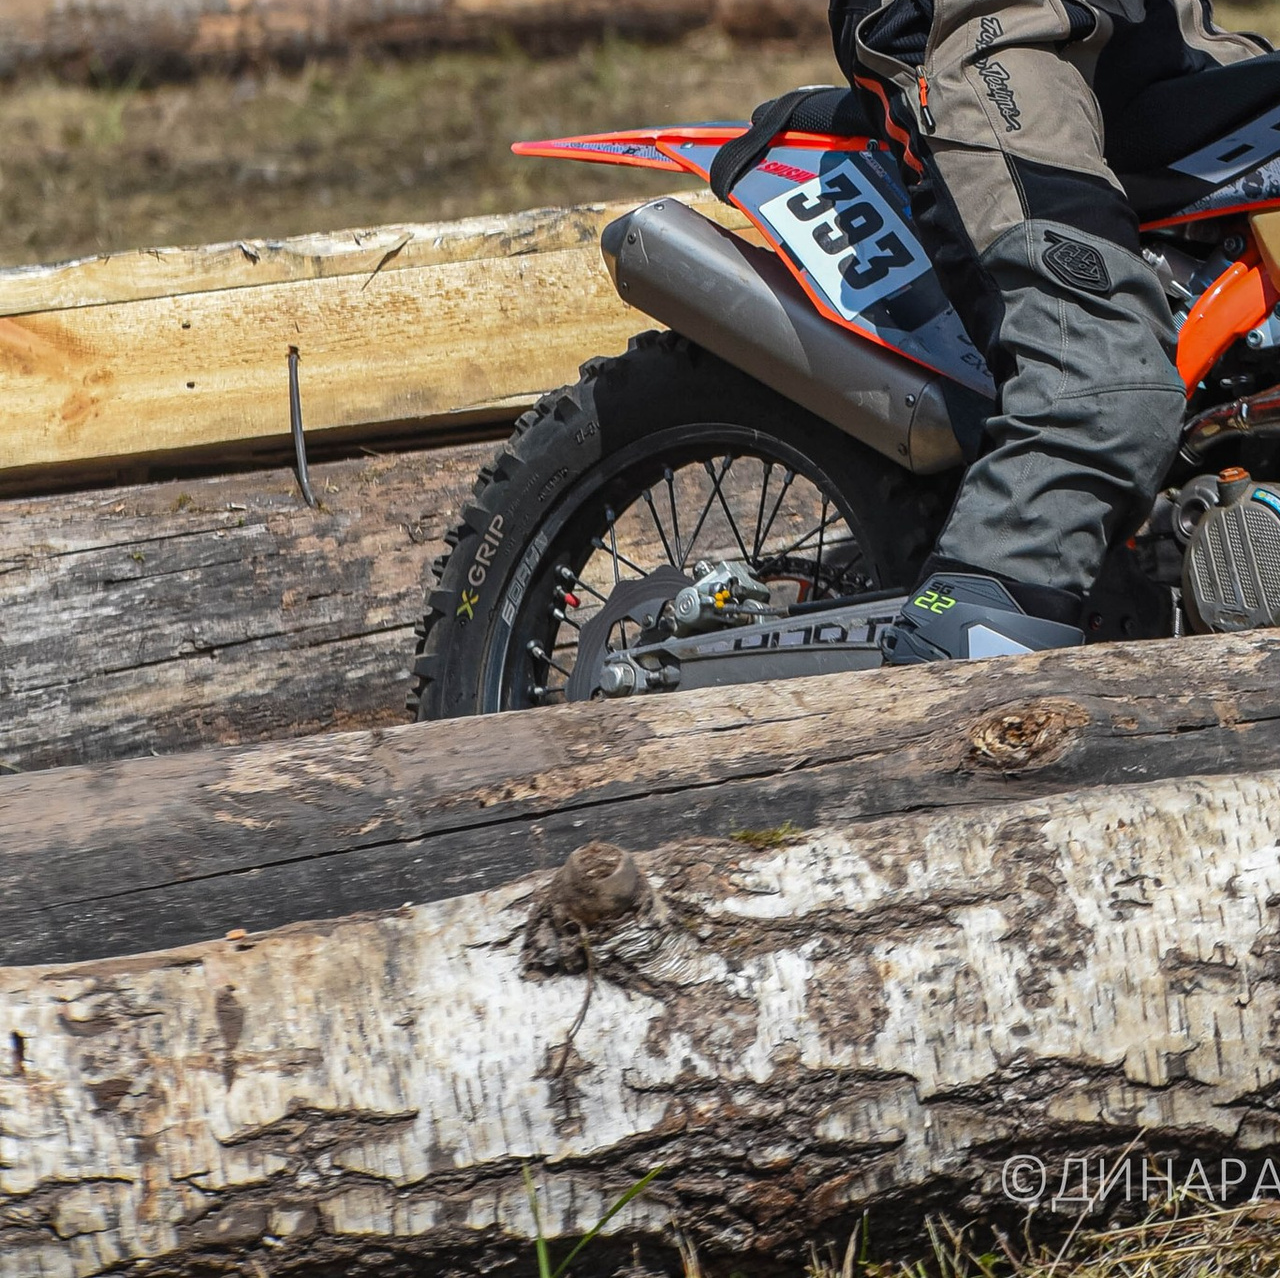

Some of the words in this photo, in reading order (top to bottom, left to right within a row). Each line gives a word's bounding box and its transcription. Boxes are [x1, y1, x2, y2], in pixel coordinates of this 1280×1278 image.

[786, 172, 916, 290] 393
[456, 514, 504, 620] X-GRIP
[914, 590, 957, 614] 22
